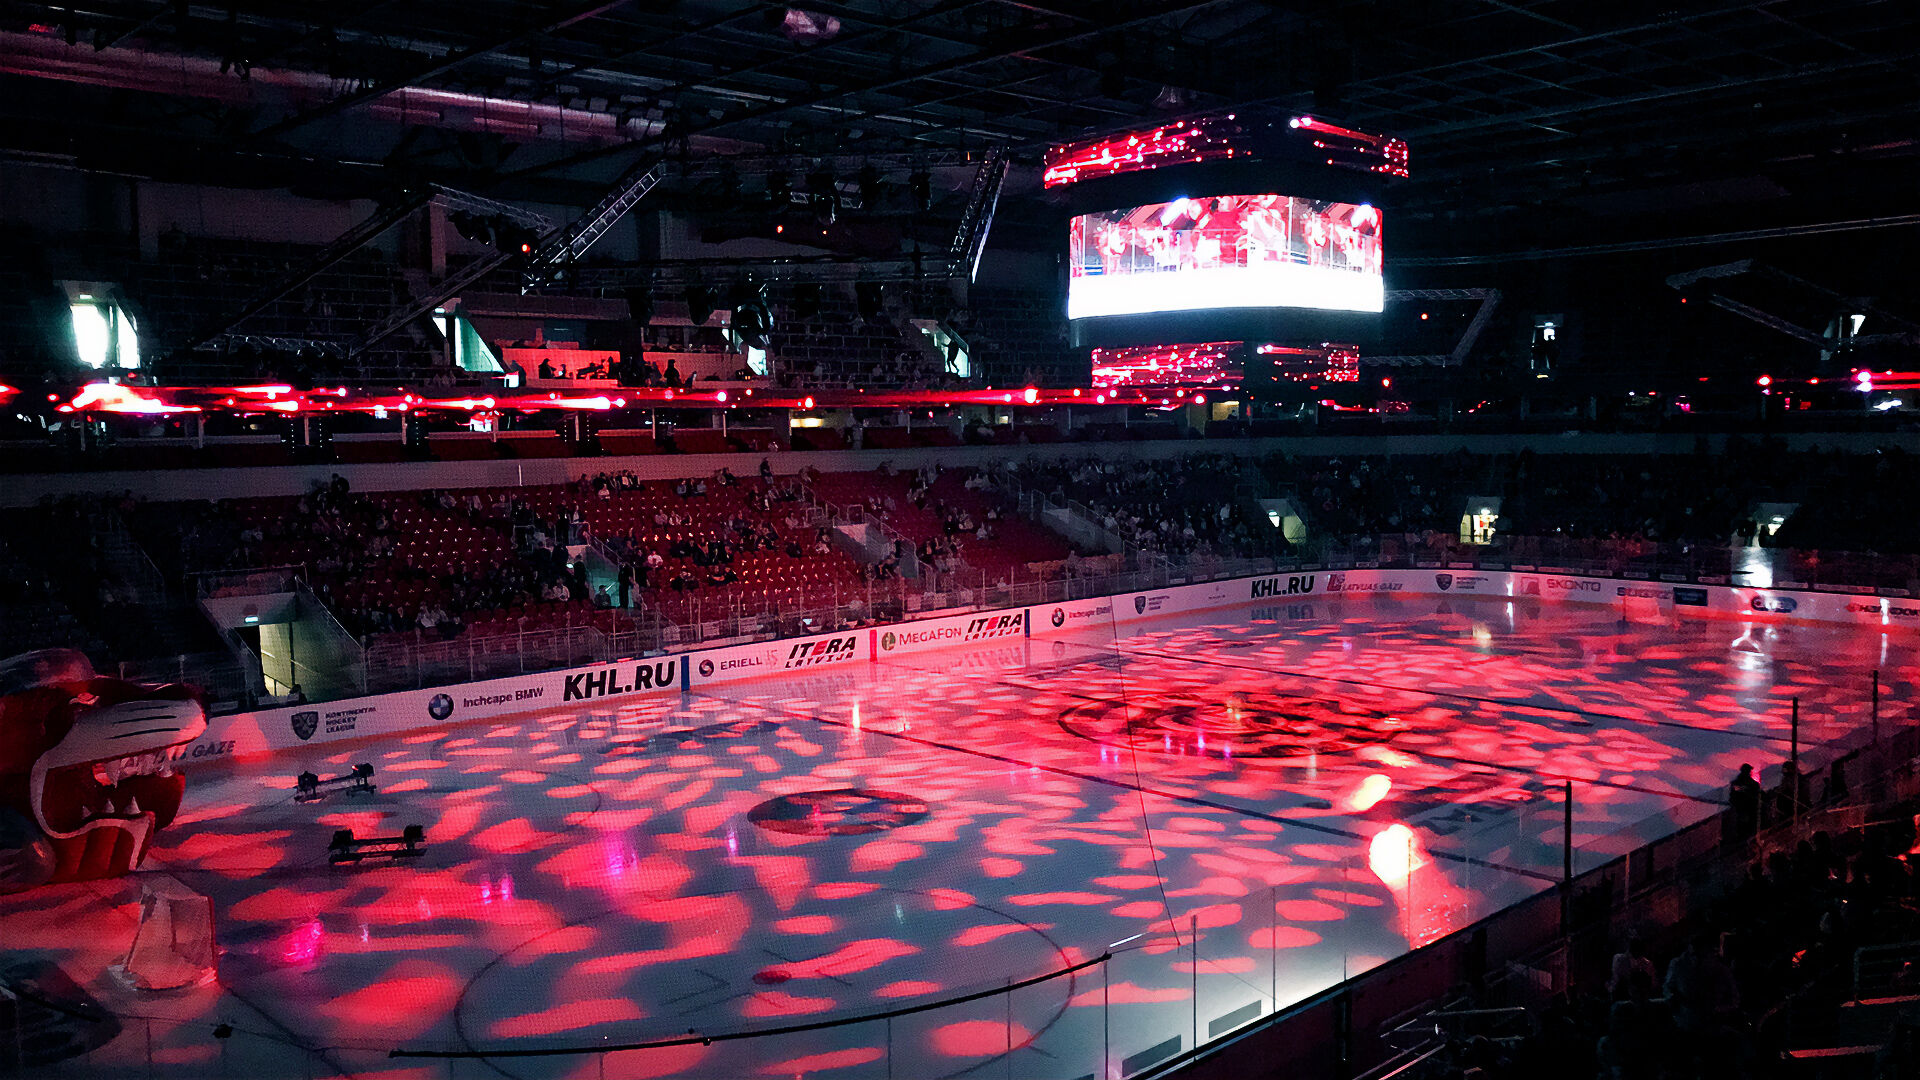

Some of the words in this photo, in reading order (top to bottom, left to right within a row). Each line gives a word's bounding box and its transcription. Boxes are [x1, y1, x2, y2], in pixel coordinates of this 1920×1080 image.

[1251, 575, 1314, 598] KHL.RU
[1546, 578, 1601, 592] SKONTO
[965, 627, 1021, 641] LATVIJA
[788, 636, 856, 660] ITERA
[720, 656, 763, 671] ERIELL
[785, 652, 854, 669] LATVIJA
[563, 661, 675, 701] KHL.RU
[463, 694, 513, 708] Inchcape
[515, 686, 544, 701] BMW
